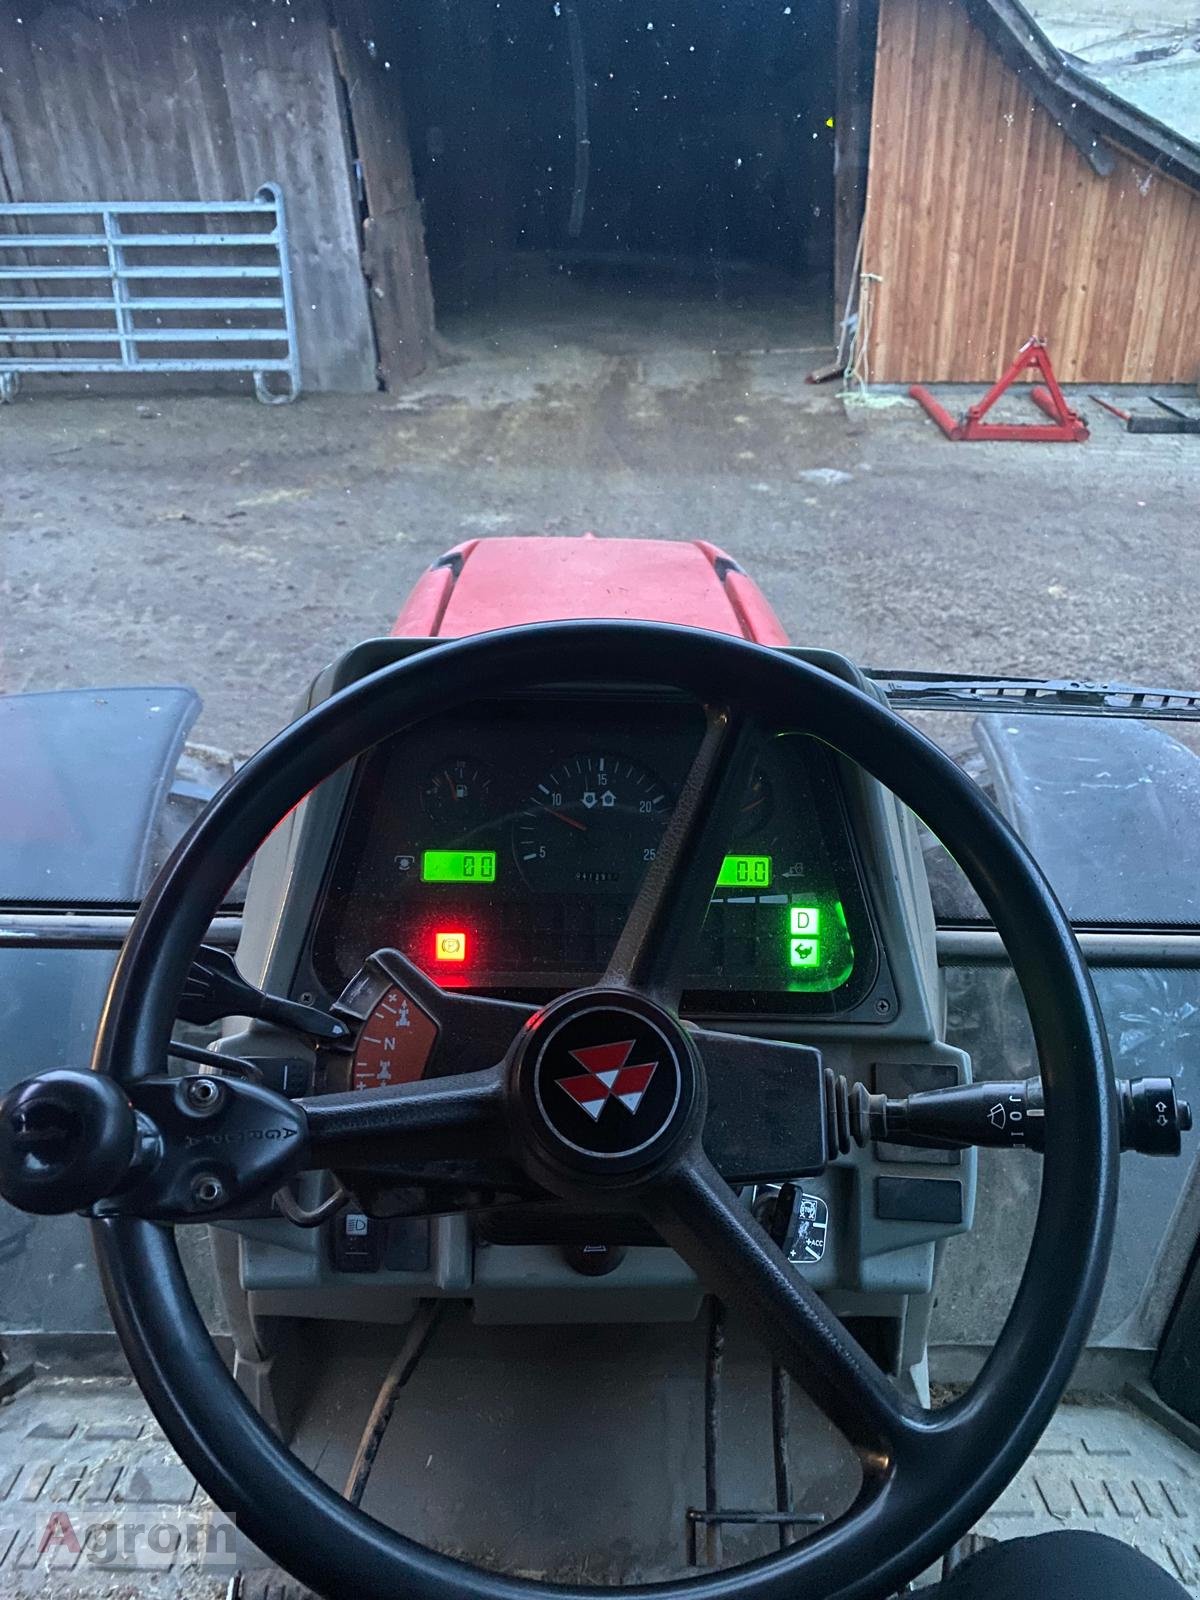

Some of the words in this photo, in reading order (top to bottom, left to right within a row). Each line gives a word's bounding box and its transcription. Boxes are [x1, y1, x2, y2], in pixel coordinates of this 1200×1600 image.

[597, 773, 608, 786] 15
[551, 792, 562, 806] 10
[639, 800, 652, 813] 20
[539, 846, 546, 858] 5
[643, 848, 656, 861] 25
[736, 860, 766, 882] 0.0
[797, 911, 810, 929] D
[384, 1037, 396, 1050] N
